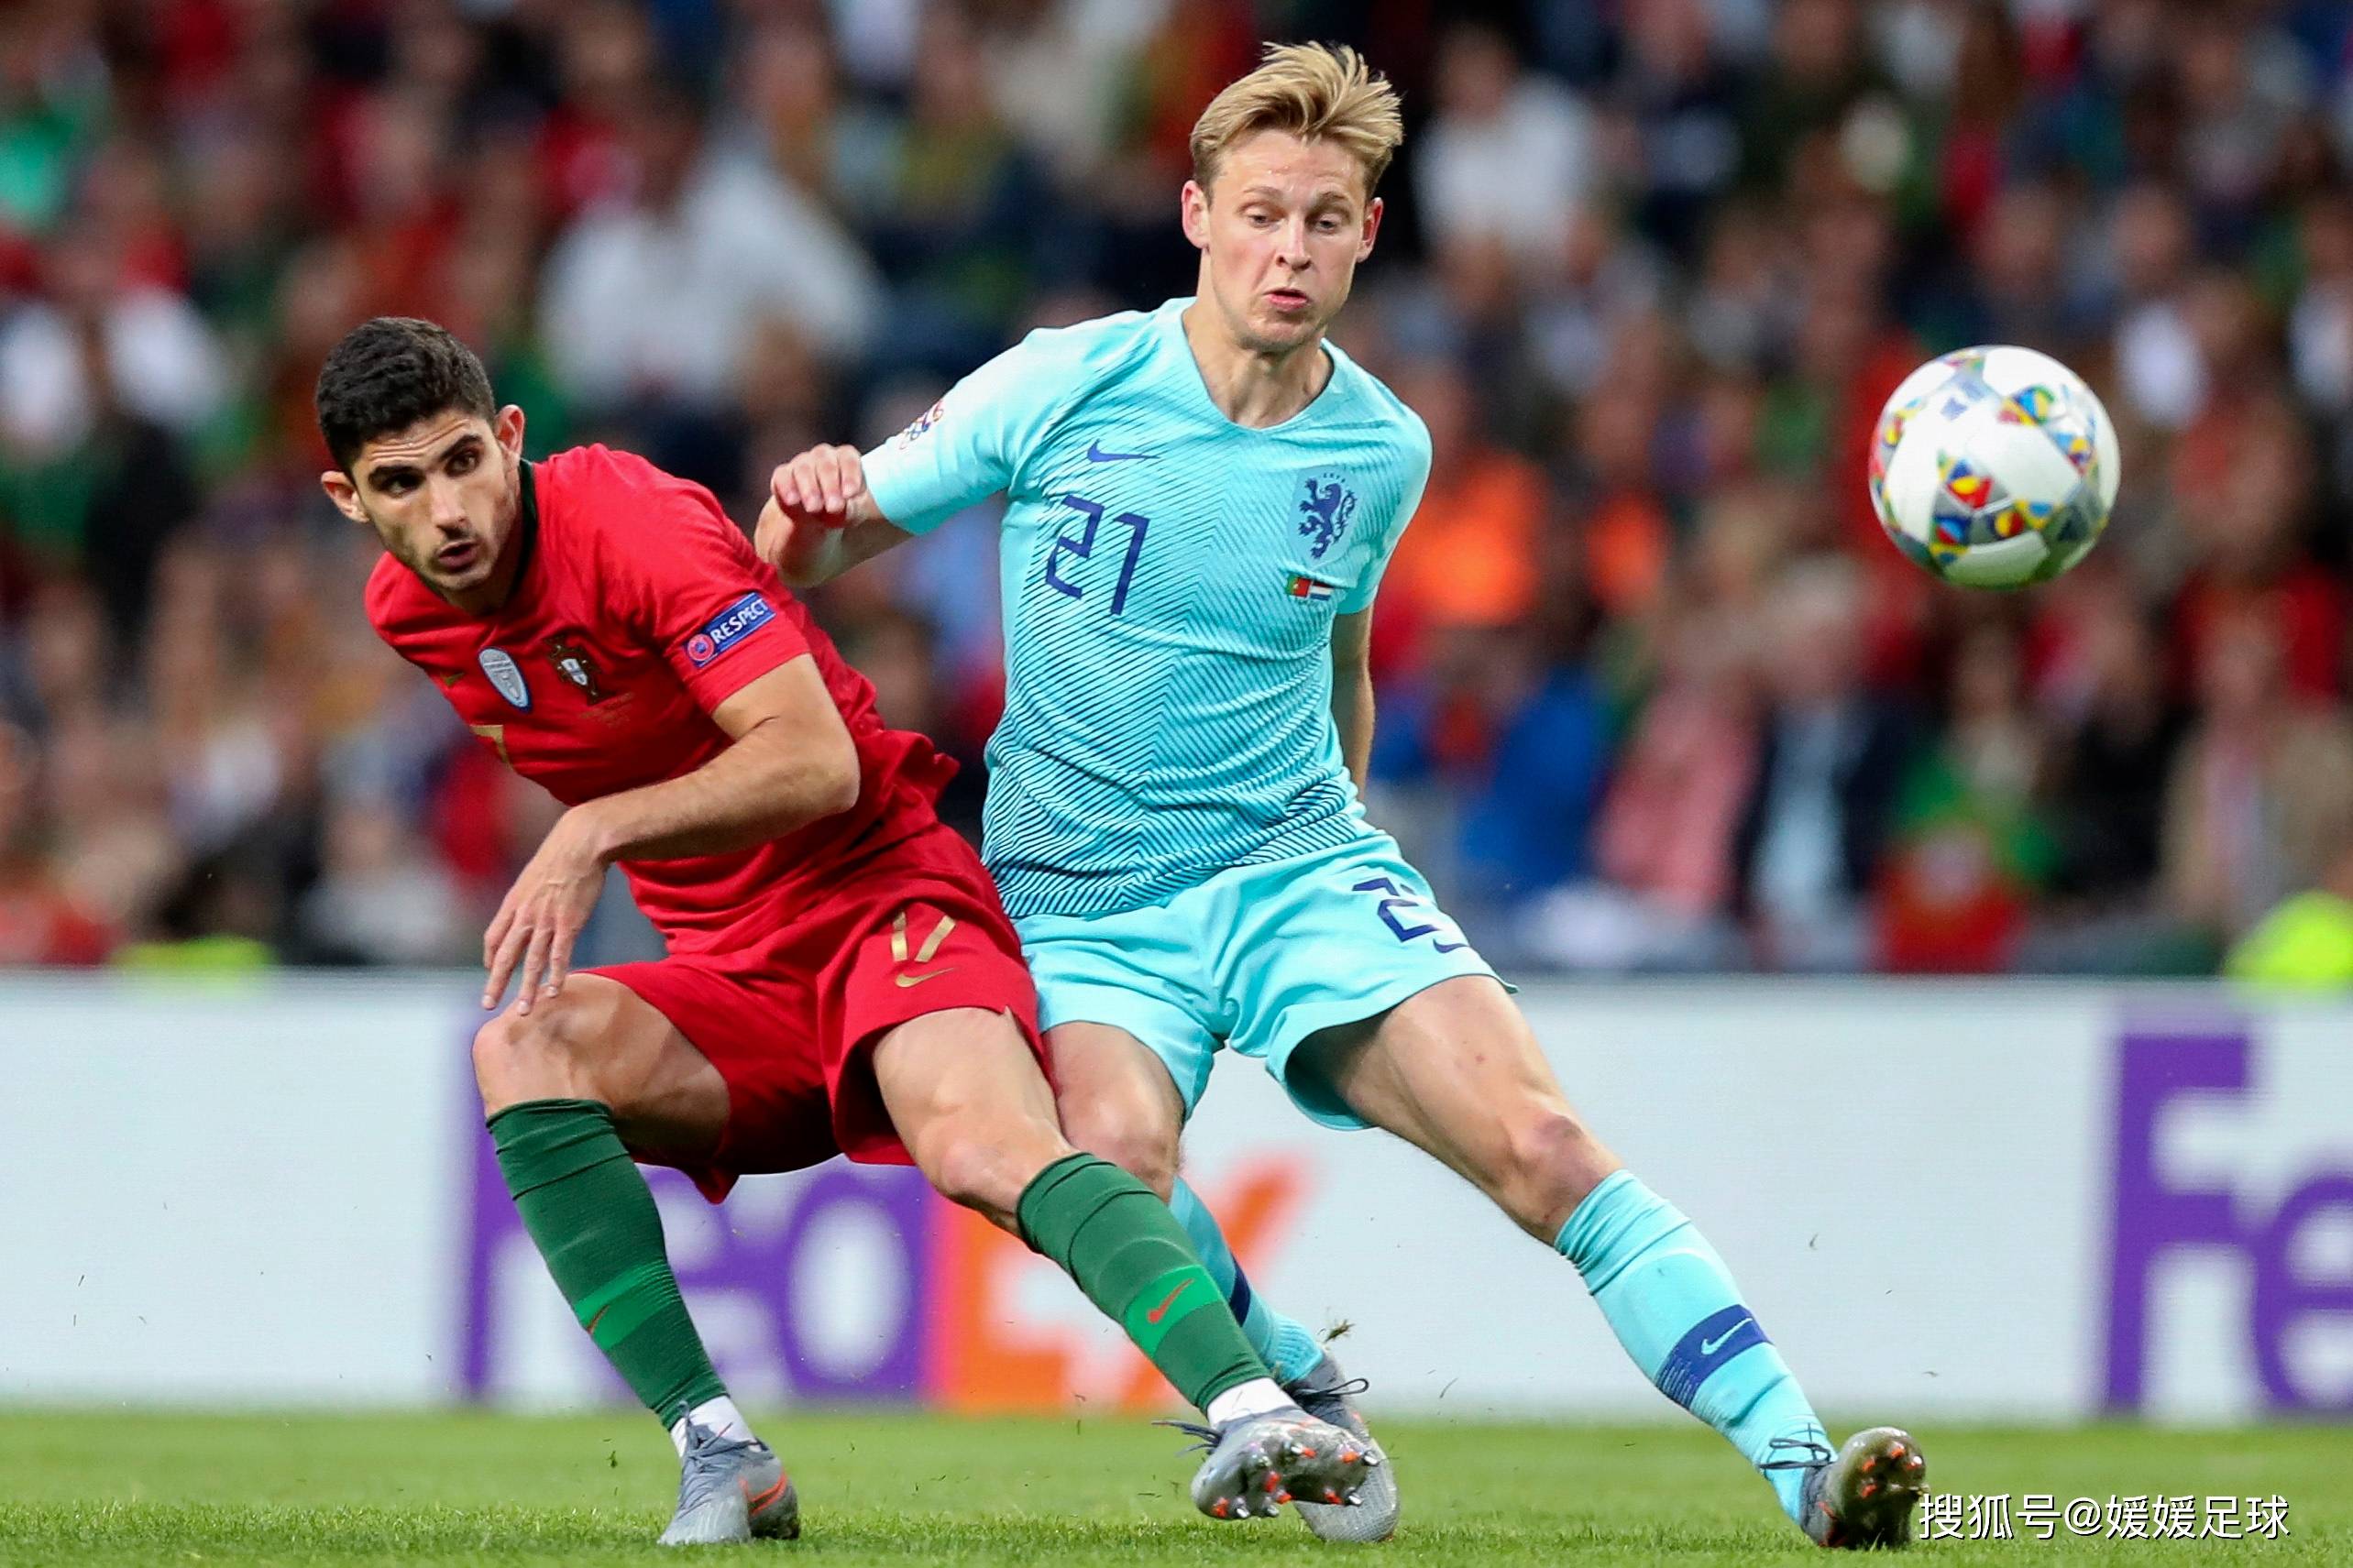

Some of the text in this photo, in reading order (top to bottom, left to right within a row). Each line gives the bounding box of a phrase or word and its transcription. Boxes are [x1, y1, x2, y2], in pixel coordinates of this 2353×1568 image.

[1045, 494, 1151, 616] 21
[709, 598, 769, 644] RESPECT
[1351, 876, 1443, 943] 2
